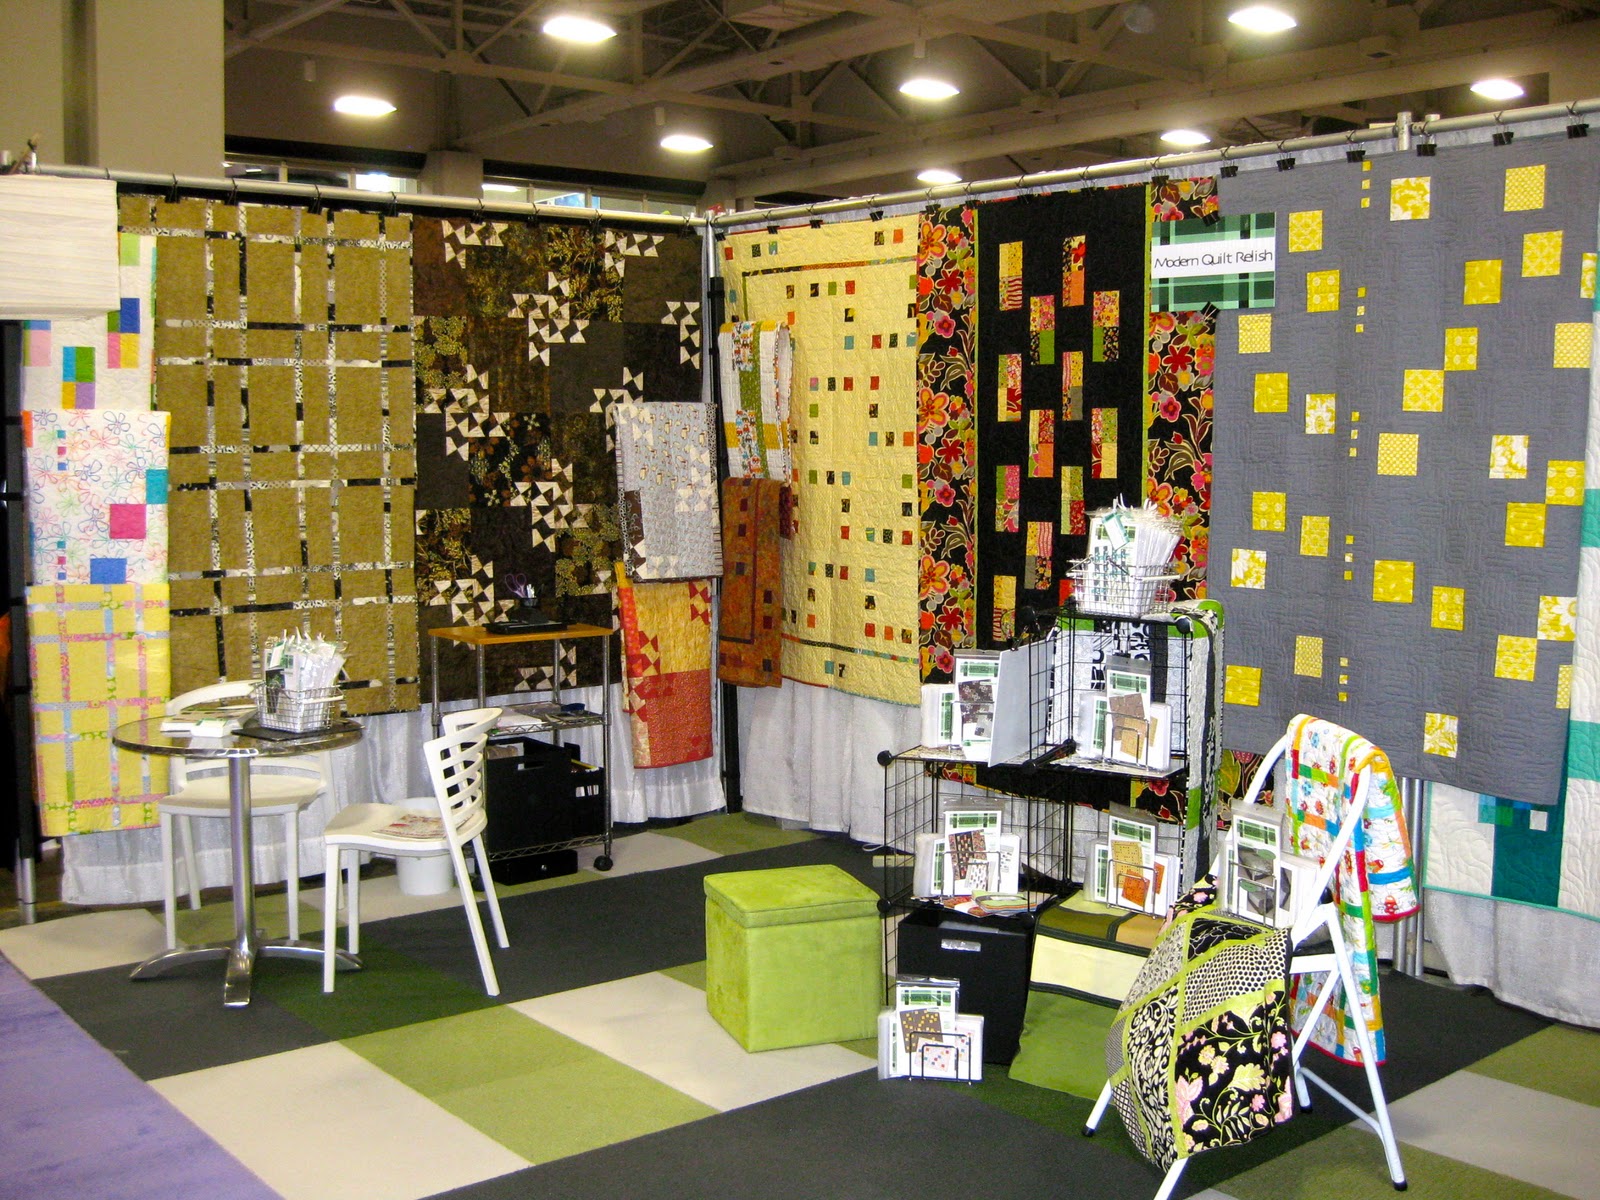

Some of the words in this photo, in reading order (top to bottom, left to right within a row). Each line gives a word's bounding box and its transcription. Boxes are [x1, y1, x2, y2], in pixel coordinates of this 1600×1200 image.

[1154, 255, 1199, 268] Modern
[1201, 252, 1233, 266] Quilt
[1235, 249, 1273, 263] Relish
